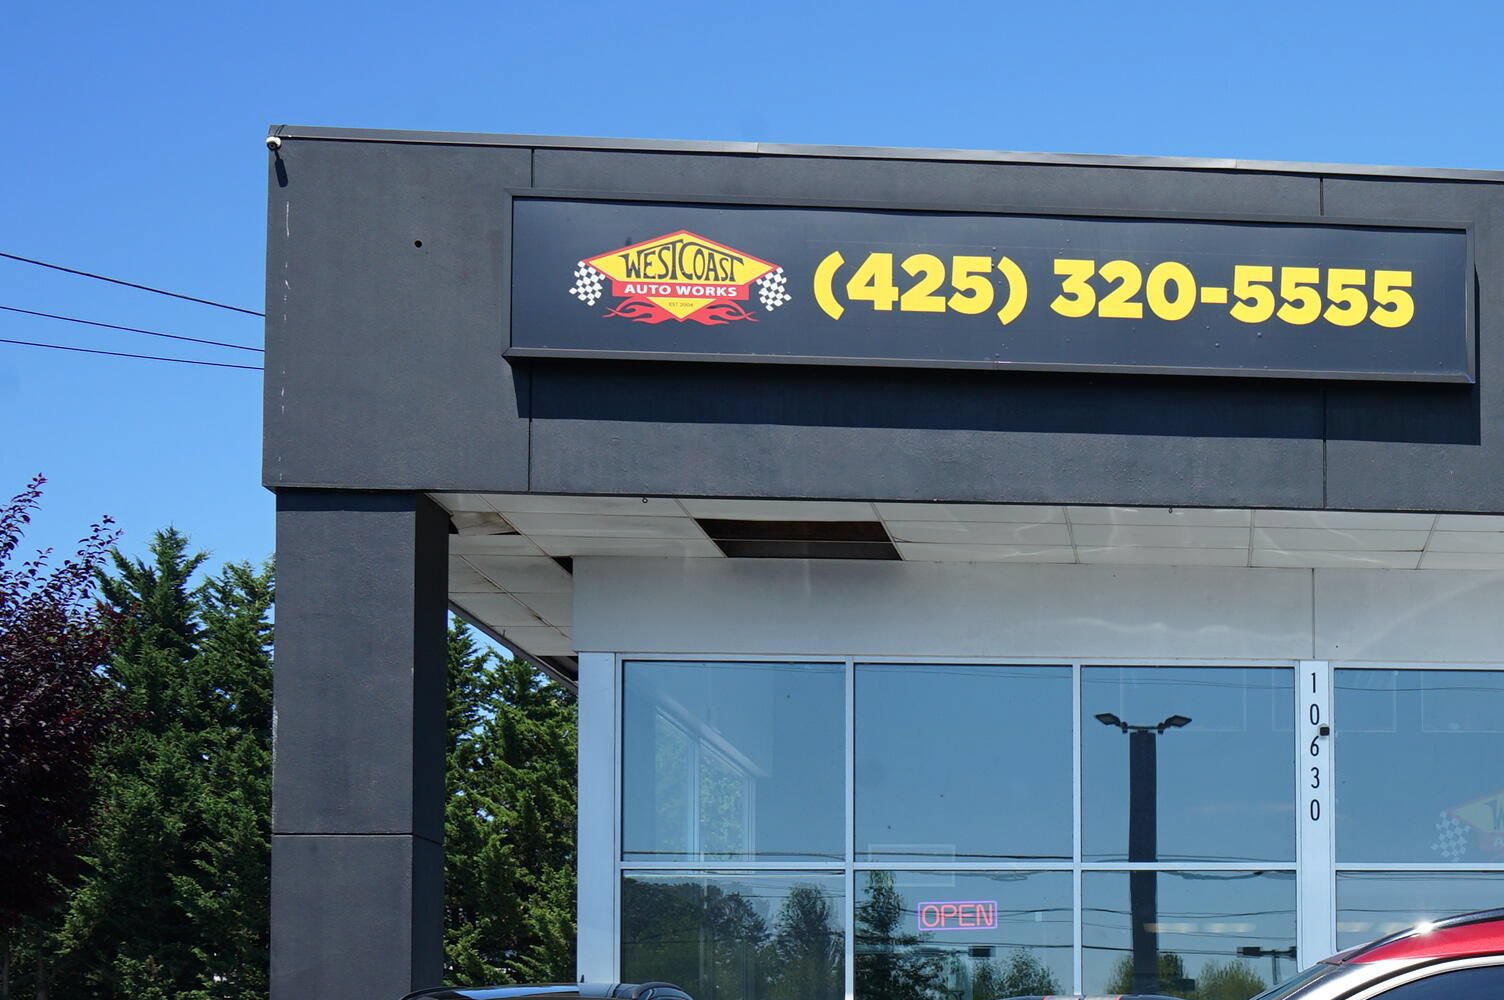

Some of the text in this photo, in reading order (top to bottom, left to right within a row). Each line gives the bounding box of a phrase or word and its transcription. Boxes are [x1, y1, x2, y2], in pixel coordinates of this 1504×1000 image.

[624, 284, 738, 297] AUTO WORKS
[813, 250, 1415, 329] (425) 320-5555
[1309, 672, 1320, 821] 10630
[922, 904, 993, 928] OPEN
